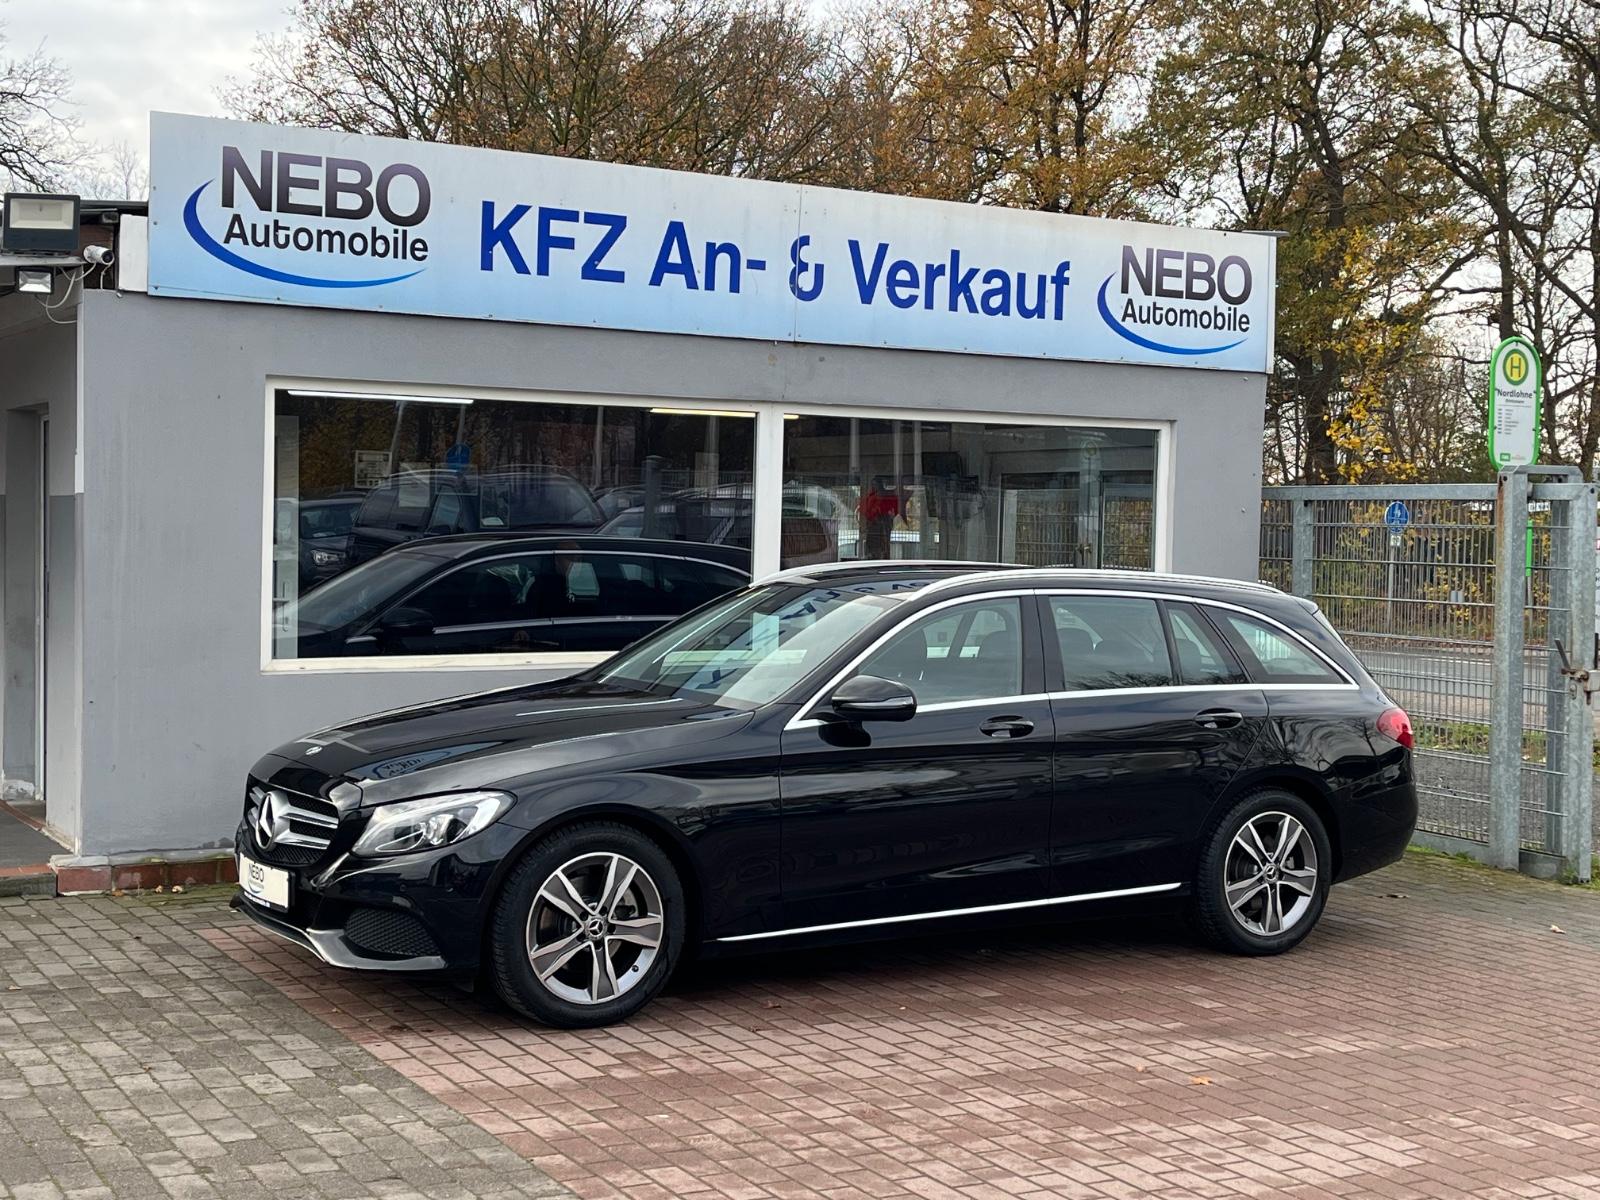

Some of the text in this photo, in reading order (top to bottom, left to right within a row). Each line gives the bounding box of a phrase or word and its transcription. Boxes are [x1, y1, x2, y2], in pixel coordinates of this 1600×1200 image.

[221, 145, 431, 227] NEBO
[223, 213, 429, 262] Automobile
[480, 200, 1071, 322] KFZ An- & Verkauf
[1120, 245, 1253, 306] NEBO
[1121, 298, 1251, 334] Automobile
[1510, 356, 1521, 378] H
[1497, 389, 1533, 399] Nordlohne
